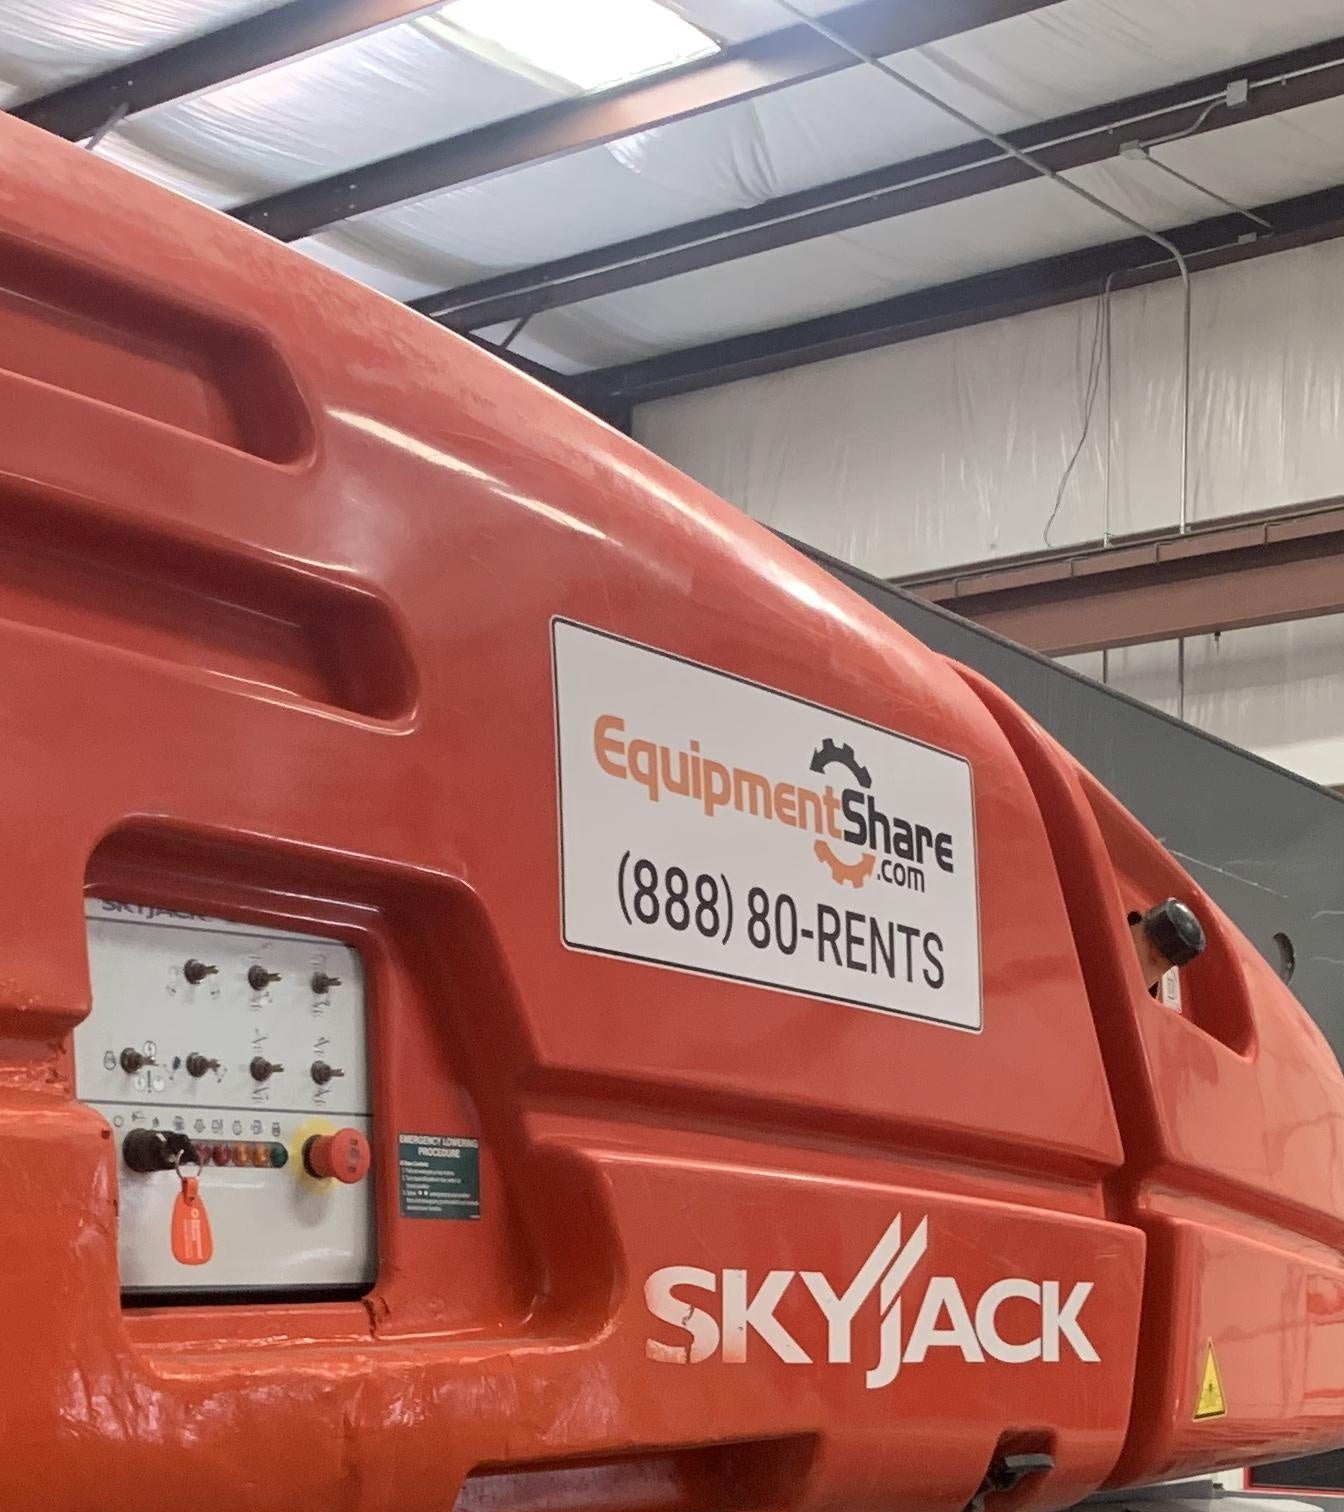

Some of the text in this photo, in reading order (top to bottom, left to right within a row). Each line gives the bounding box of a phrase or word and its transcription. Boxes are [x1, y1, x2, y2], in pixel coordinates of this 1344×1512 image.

[593, 713, 954, 874] EquipmentShare
[618, 850, 945, 991] (888) 80-RENTS
[876, 858, 926, 893] .com
[643, 1211, 1102, 1389] SKYJACK
